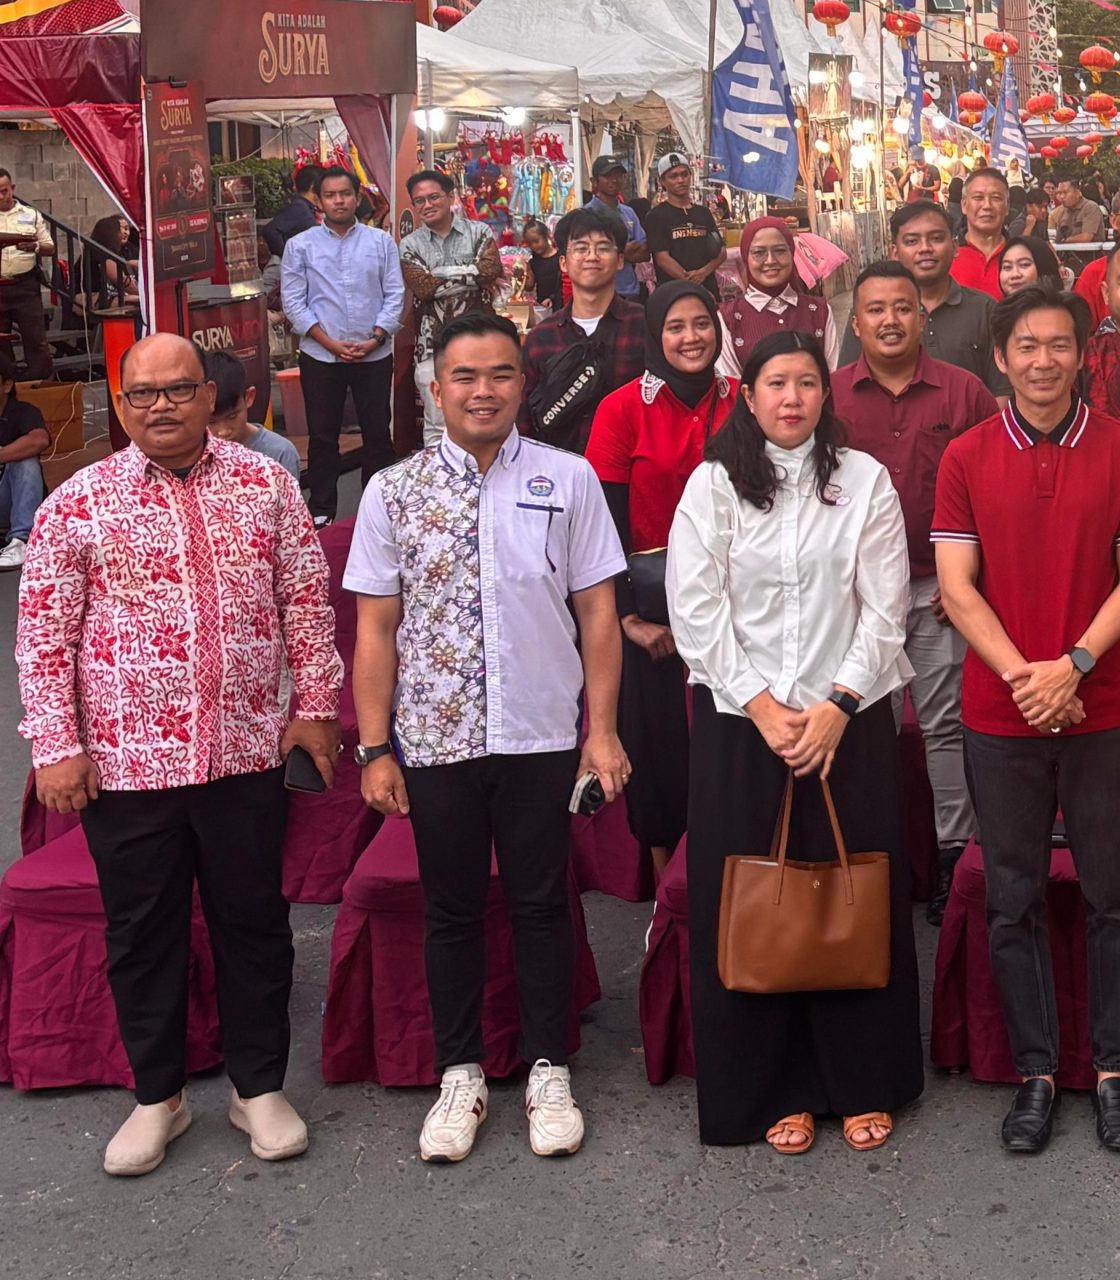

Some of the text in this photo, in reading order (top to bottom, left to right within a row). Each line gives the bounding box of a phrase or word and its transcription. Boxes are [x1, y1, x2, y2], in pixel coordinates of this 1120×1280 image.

[277, 13, 326, 28] KITA ADALAH
[258, 11, 330, 84] SURYA
[160, 100, 192, 131] SURYA
[543, 373, 589, 425] CONVERSE
